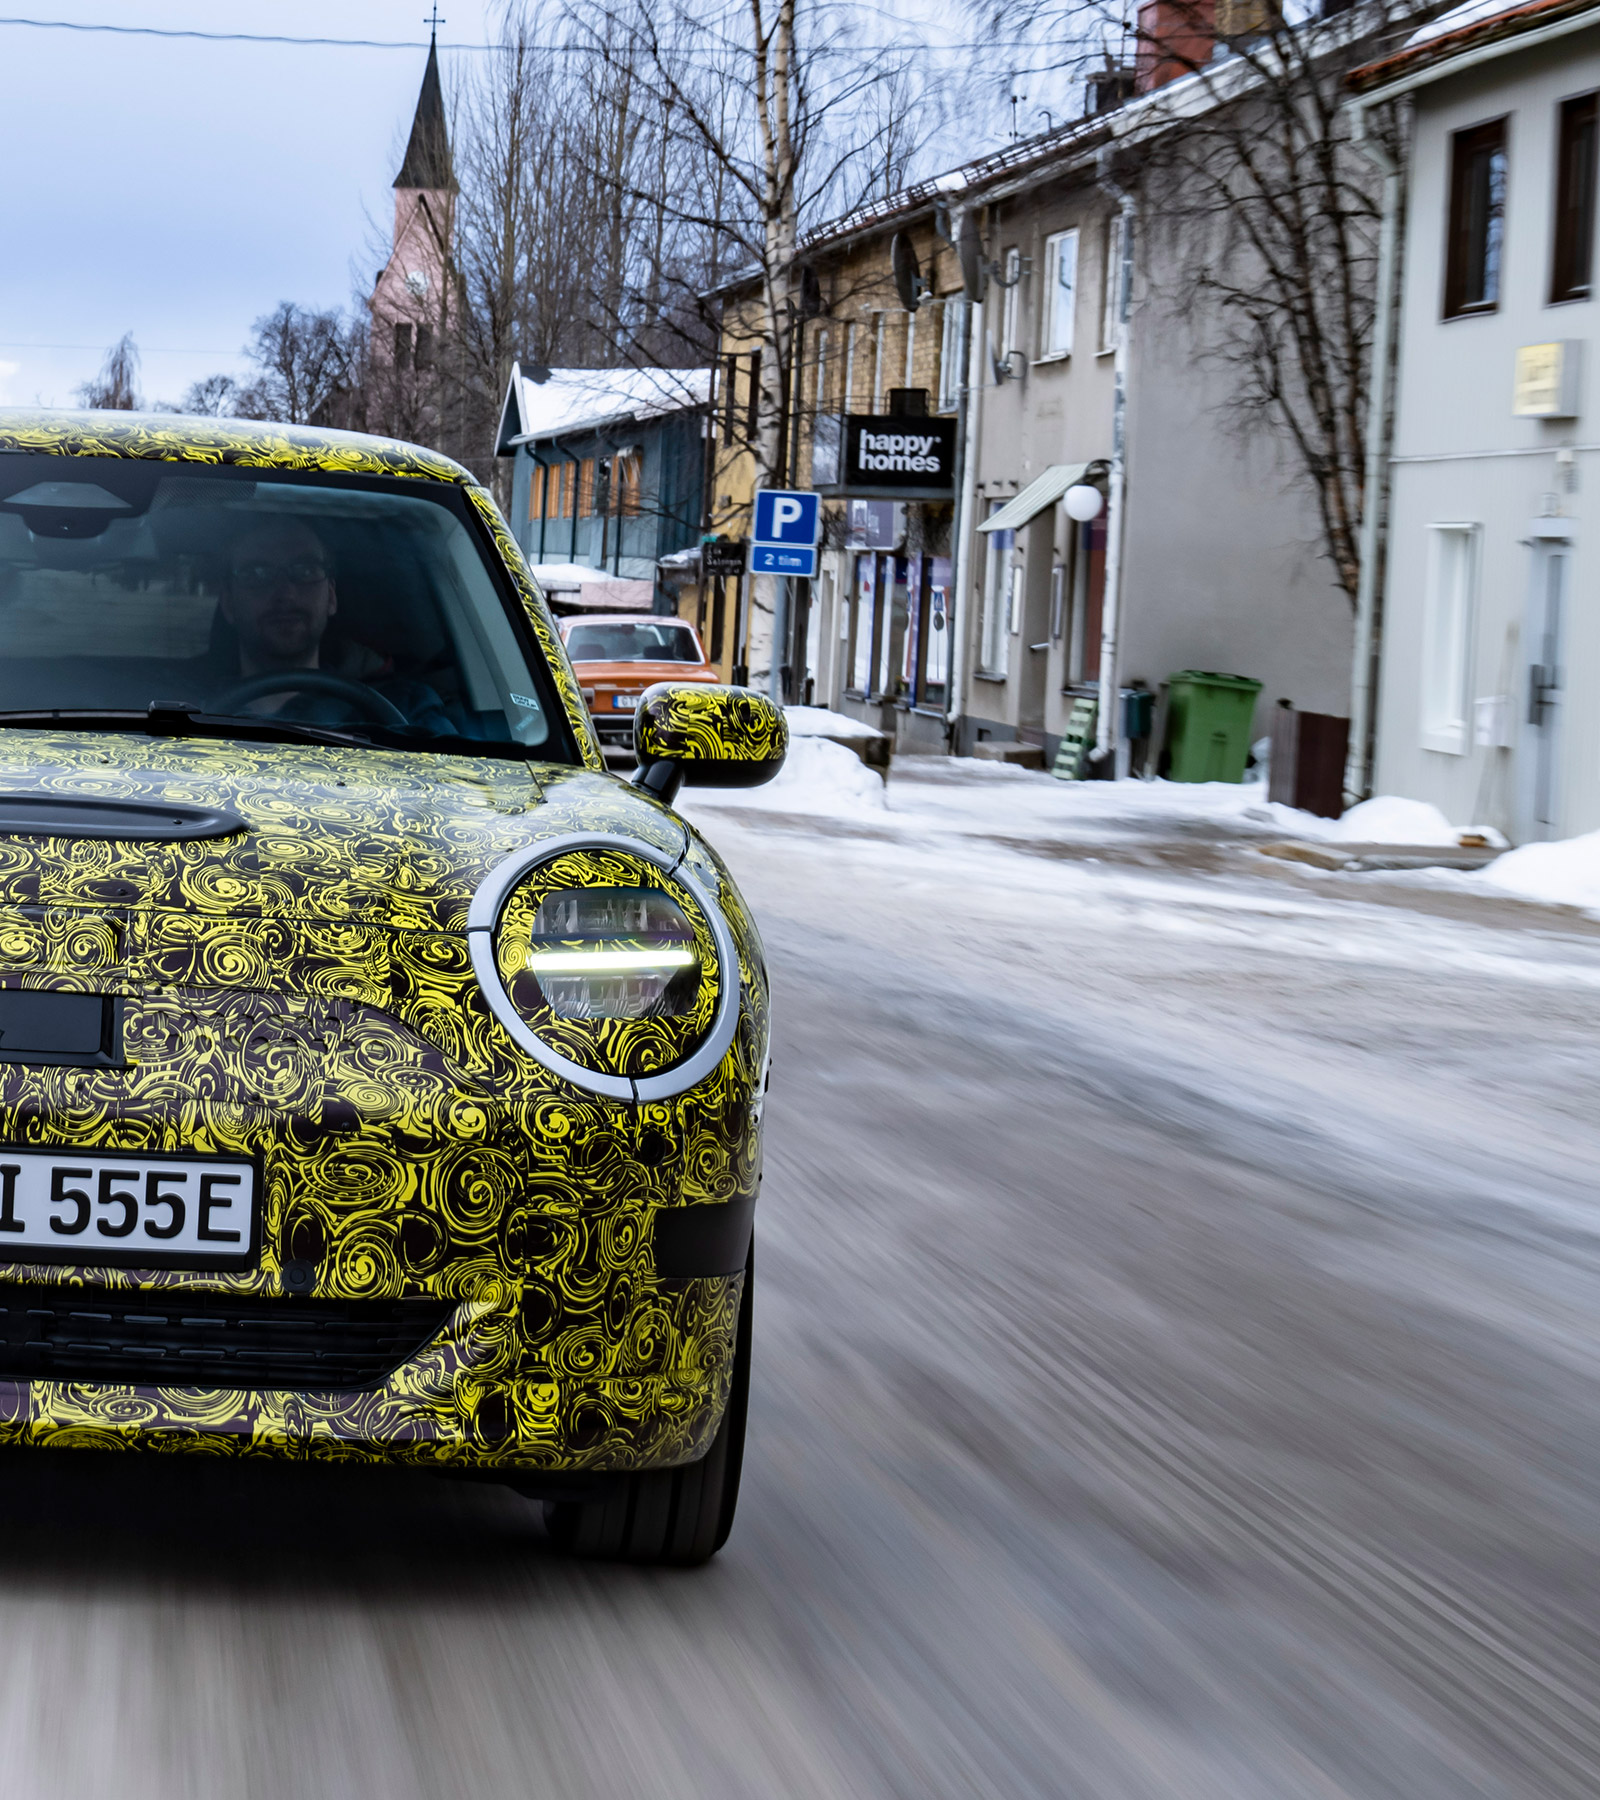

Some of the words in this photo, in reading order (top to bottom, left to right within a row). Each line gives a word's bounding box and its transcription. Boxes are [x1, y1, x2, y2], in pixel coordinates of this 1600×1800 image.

[860, 428, 934, 456] happy
[859, 449, 941, 473] homes
[771, 497, 804, 538] P
[764, 553, 775, 566] 2
[50, 1166, 242, 1242] 555E
